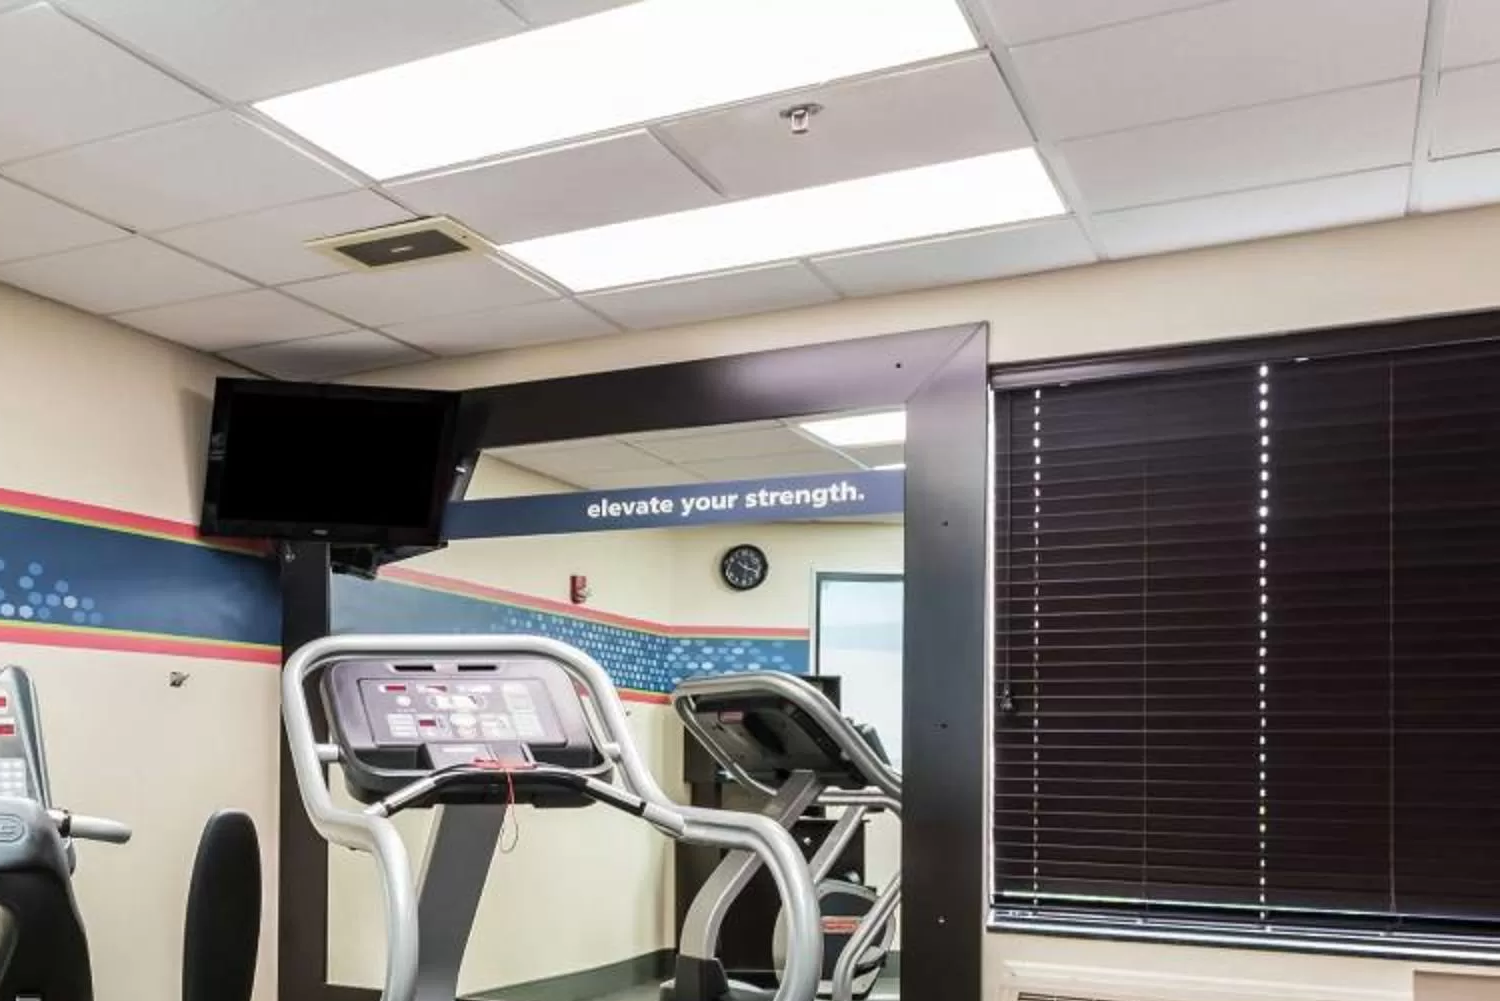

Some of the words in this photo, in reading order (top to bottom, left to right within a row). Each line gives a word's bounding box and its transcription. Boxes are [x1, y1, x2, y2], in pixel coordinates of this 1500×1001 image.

[587, 496, 674, 518] elevate
[681, 493, 739, 517] your
[745, 480, 865, 509] strength.
